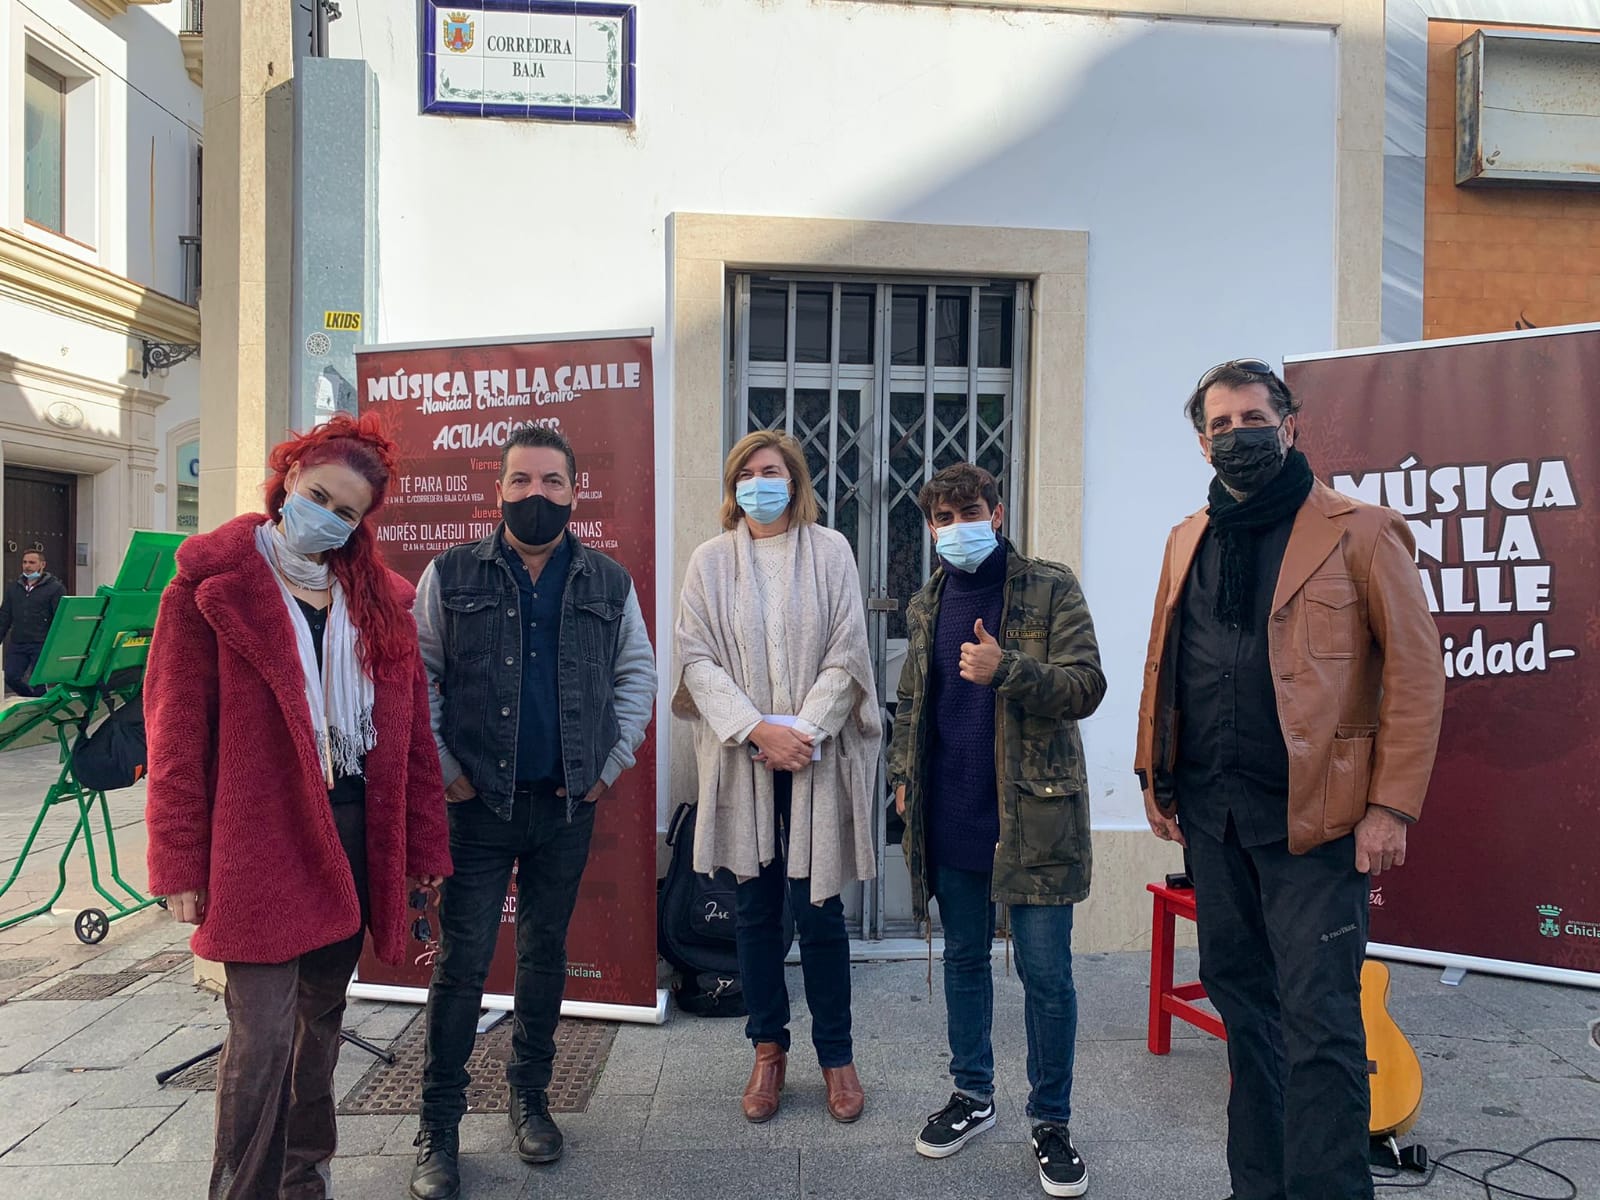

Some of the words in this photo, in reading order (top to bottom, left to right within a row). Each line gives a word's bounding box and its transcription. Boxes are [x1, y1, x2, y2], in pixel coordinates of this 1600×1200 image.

[487, 35, 572, 55] CORREDERA
[512, 61, 545, 78] BAJA
[326, 312, 360, 329] LKIDS
[367, 367, 469, 402] MÚSICA
[474, 369, 508, 397] EN
[516, 367, 550, 393] LA
[554, 362, 640, 391] CALLE
[477, 391, 531, 410] Chiclana
[400, 475, 411, 493] TÉ
[415, 476, 443, 493] PARA
[446, 475, 468, 492] DOS
[1333, 456, 1577, 515] MÚSICA
[472, 506, 502, 519] Jueves
[376, 522, 417, 541] ANDRÉS
[420, 523, 465, 541] OLAEGUI
[468, 522, 493, 539] TRIO
[1461, 515, 1541, 562] LA
